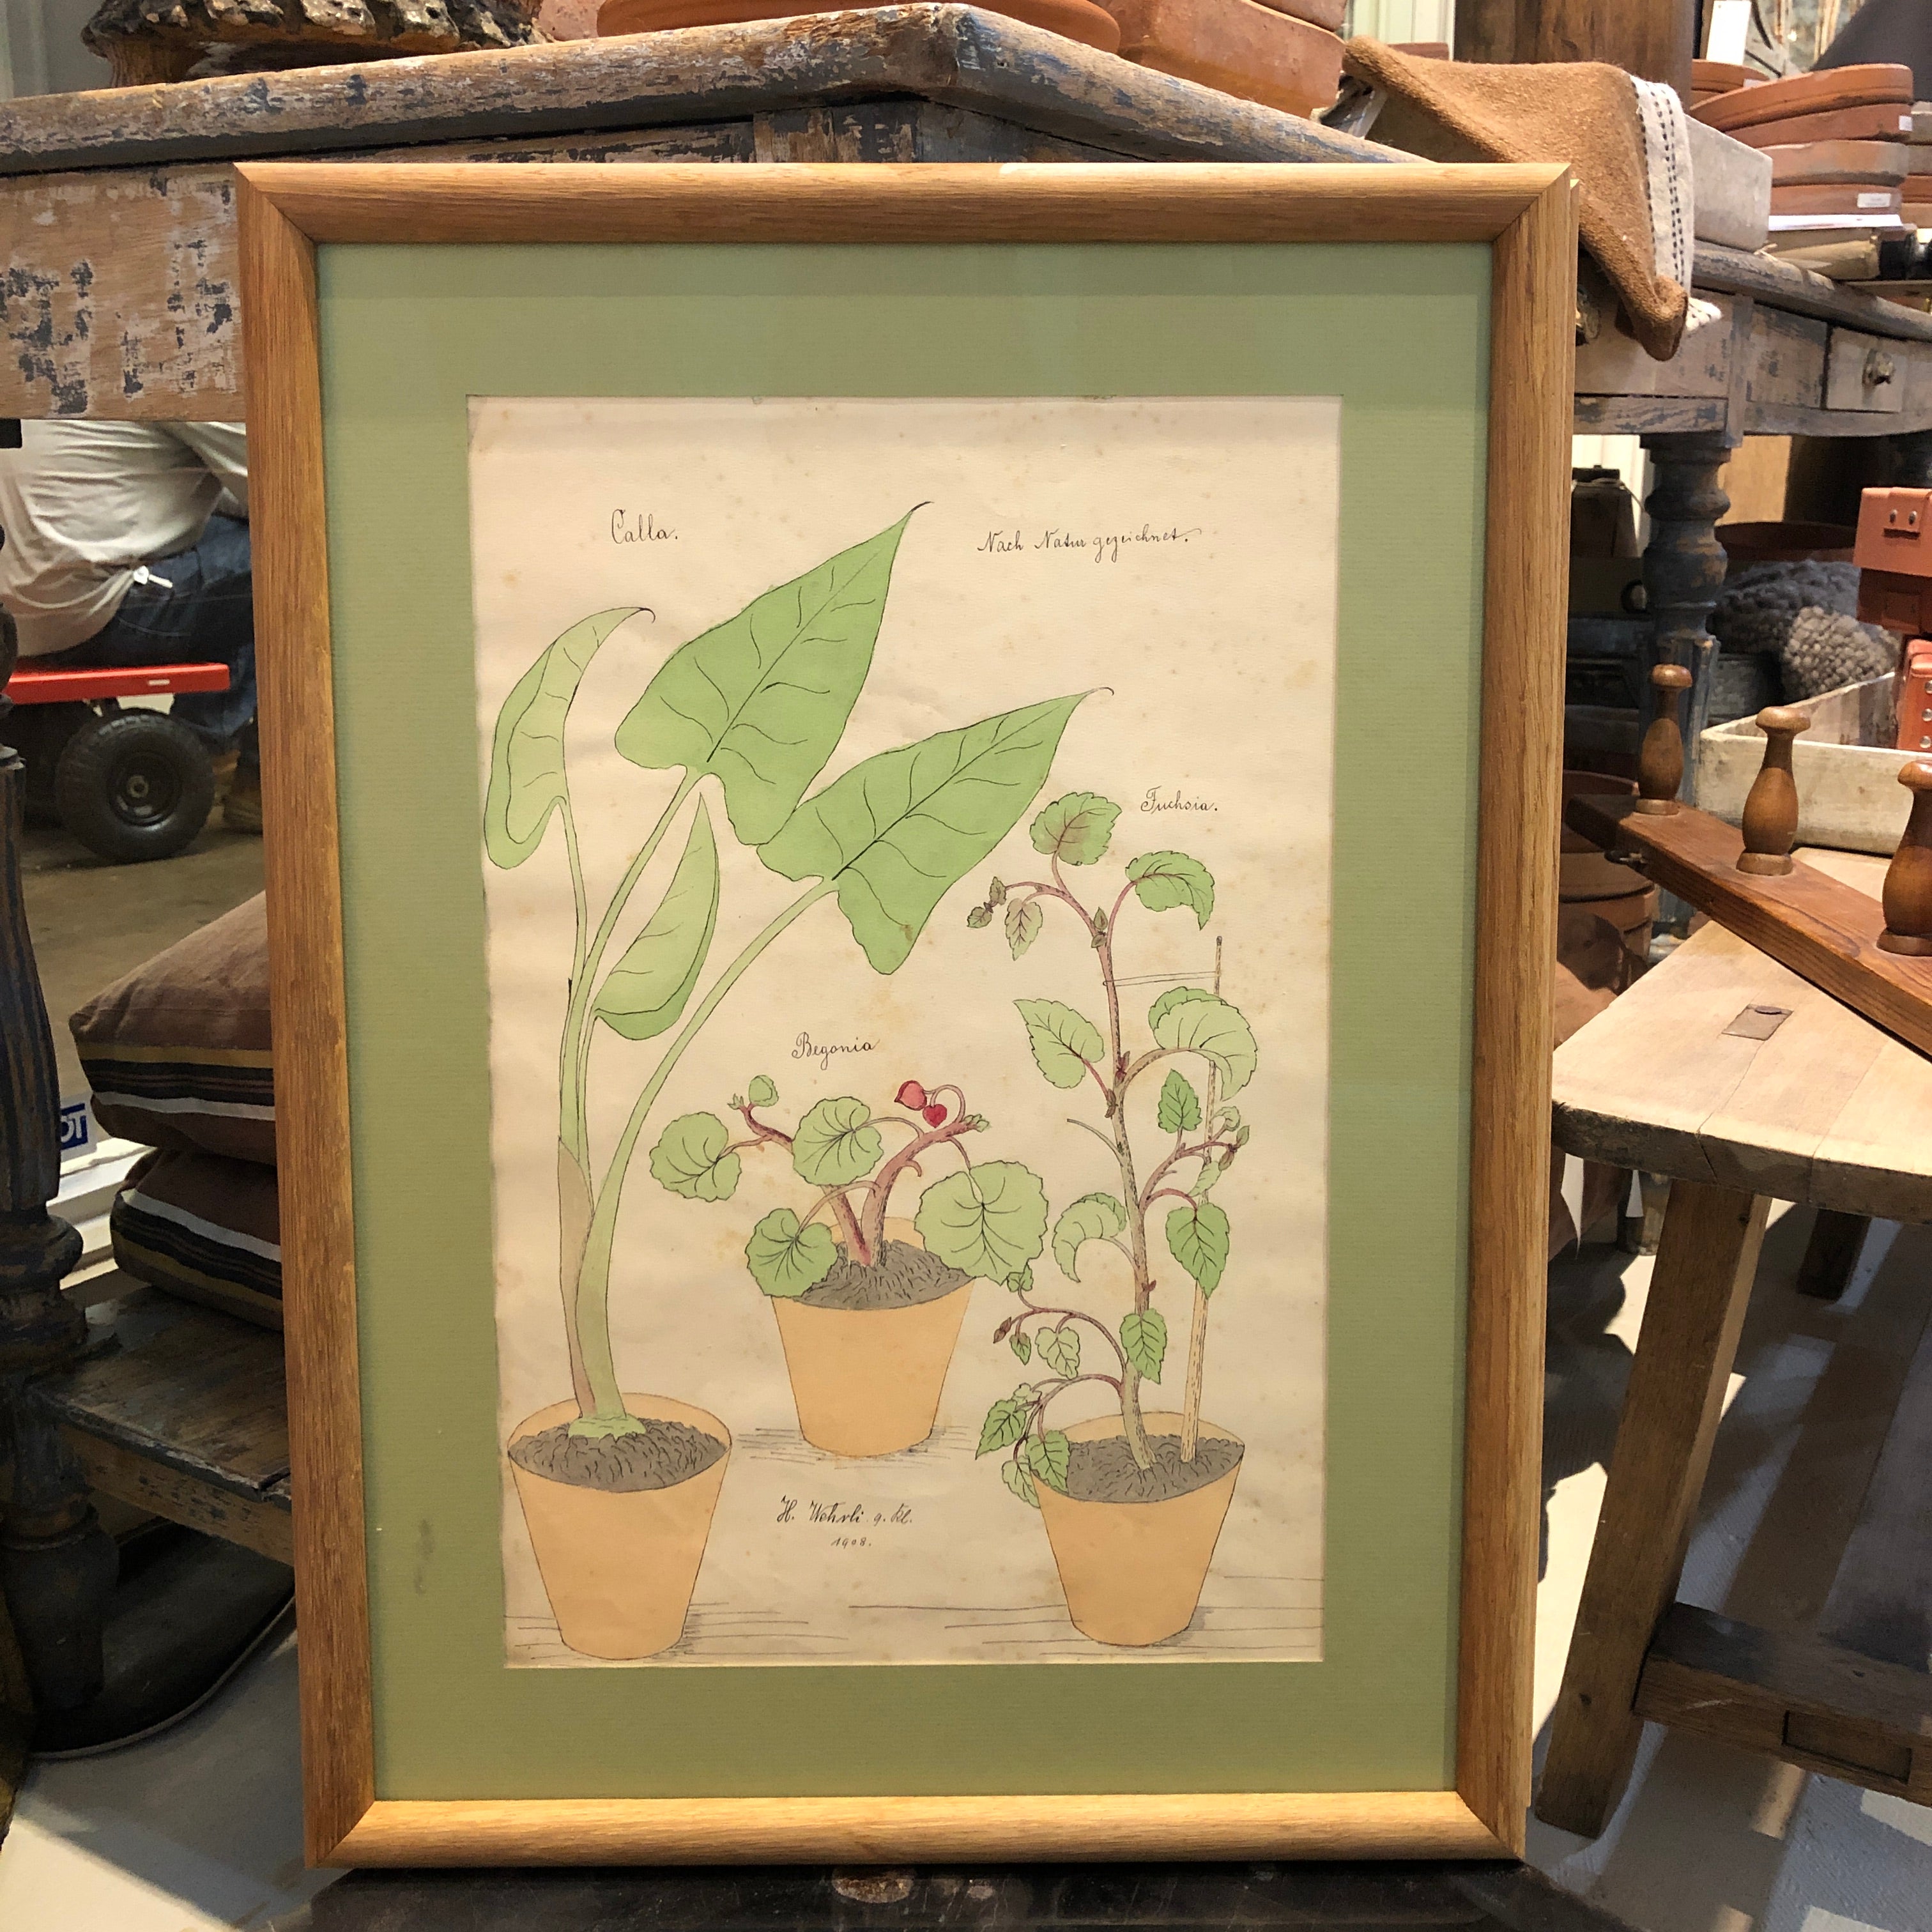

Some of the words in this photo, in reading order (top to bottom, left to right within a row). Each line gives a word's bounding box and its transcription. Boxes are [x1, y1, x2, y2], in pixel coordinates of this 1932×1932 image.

[611, 508, 678, 544] Calla.
[976, 530, 1023, 553] Nach
[1034, 528, 1086, 550] Natur
[1140, 785, 1218, 815] Fuchsia.
[791, 1031, 881, 1071] Begonia
